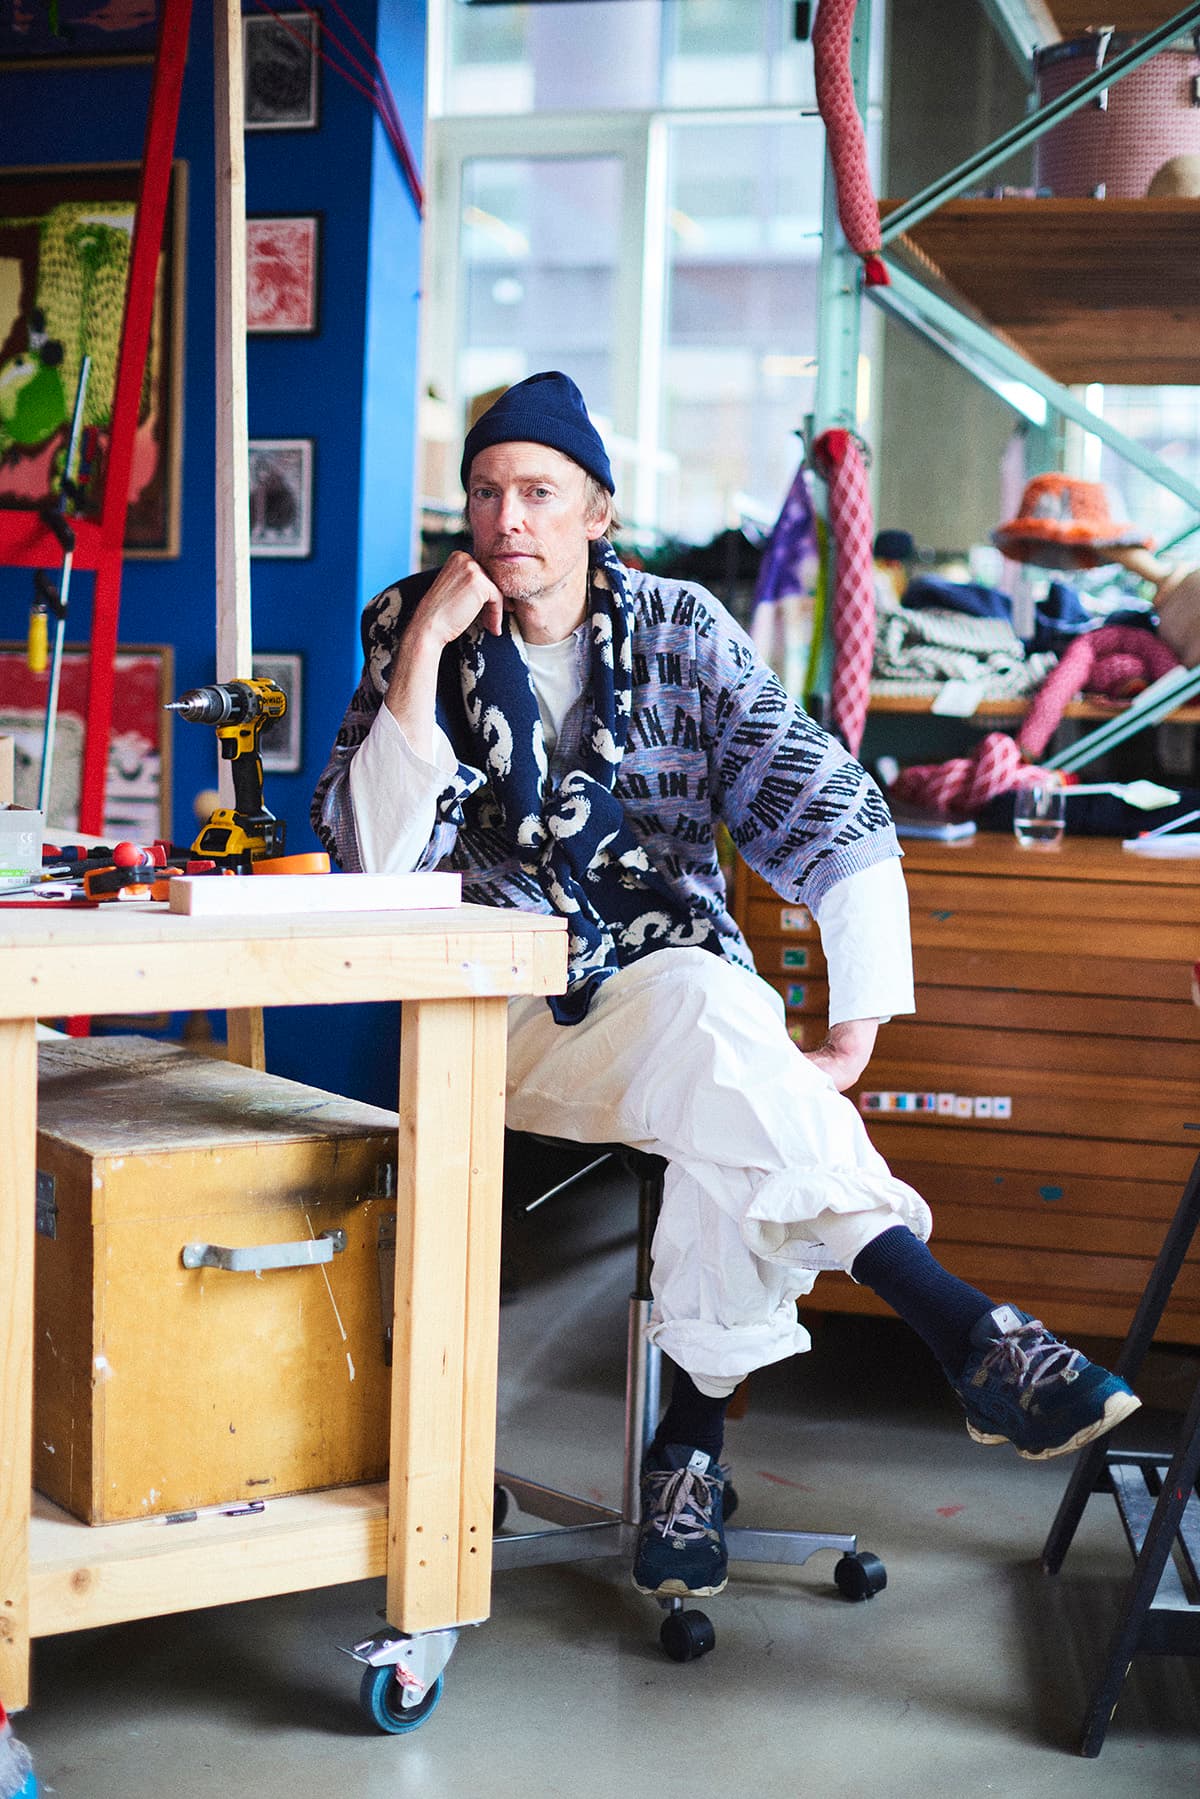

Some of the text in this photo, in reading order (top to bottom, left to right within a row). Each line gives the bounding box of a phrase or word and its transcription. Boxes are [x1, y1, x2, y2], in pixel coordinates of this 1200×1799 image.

[655, 652, 682, 686] IN
[634, 703, 668, 748] IN
[658, 771, 688, 799] IN
[819, 761, 865, 797] BIRD
